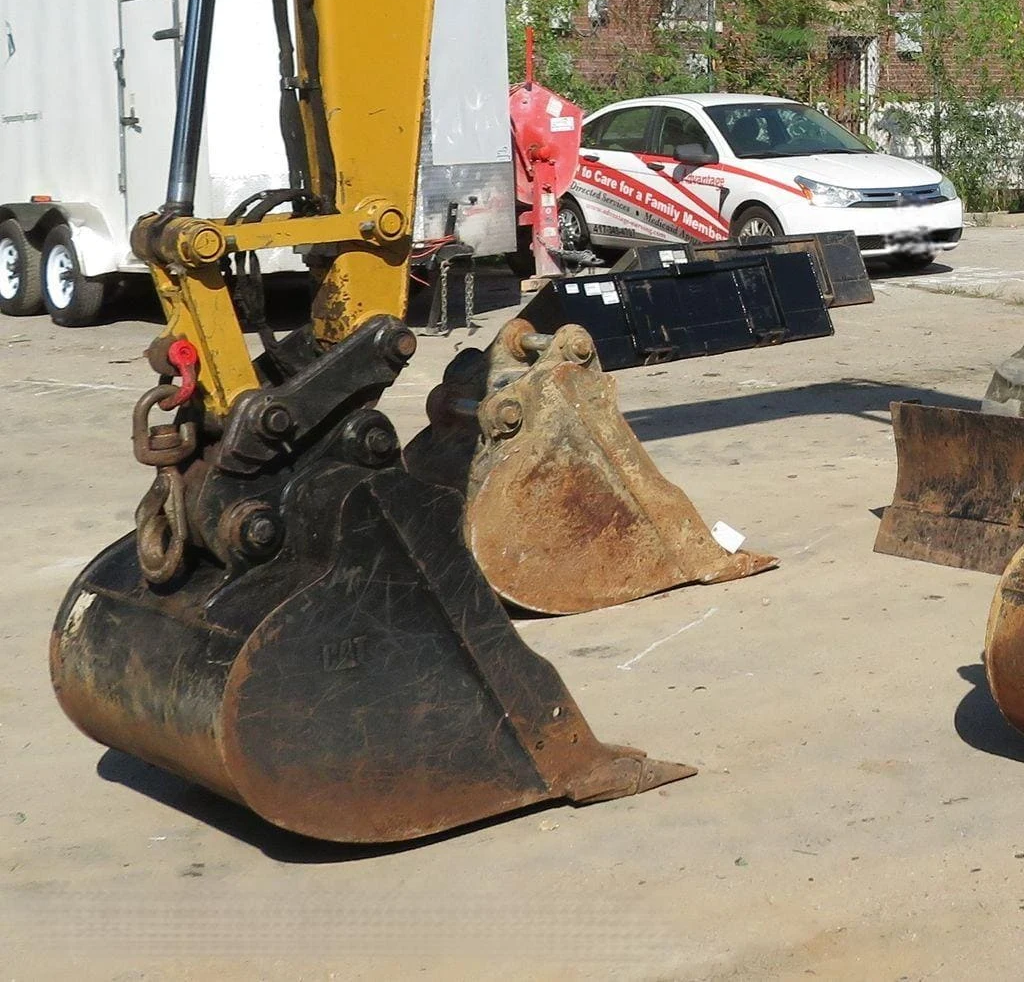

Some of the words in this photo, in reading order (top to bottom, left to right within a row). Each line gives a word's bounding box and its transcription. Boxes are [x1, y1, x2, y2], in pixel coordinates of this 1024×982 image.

[581, 165, 592, 179] to
[594, 170, 618, 189] Care
[620, 180, 634, 196] for
[635, 191, 643, 201] a
[644, 192, 680, 222] Family
